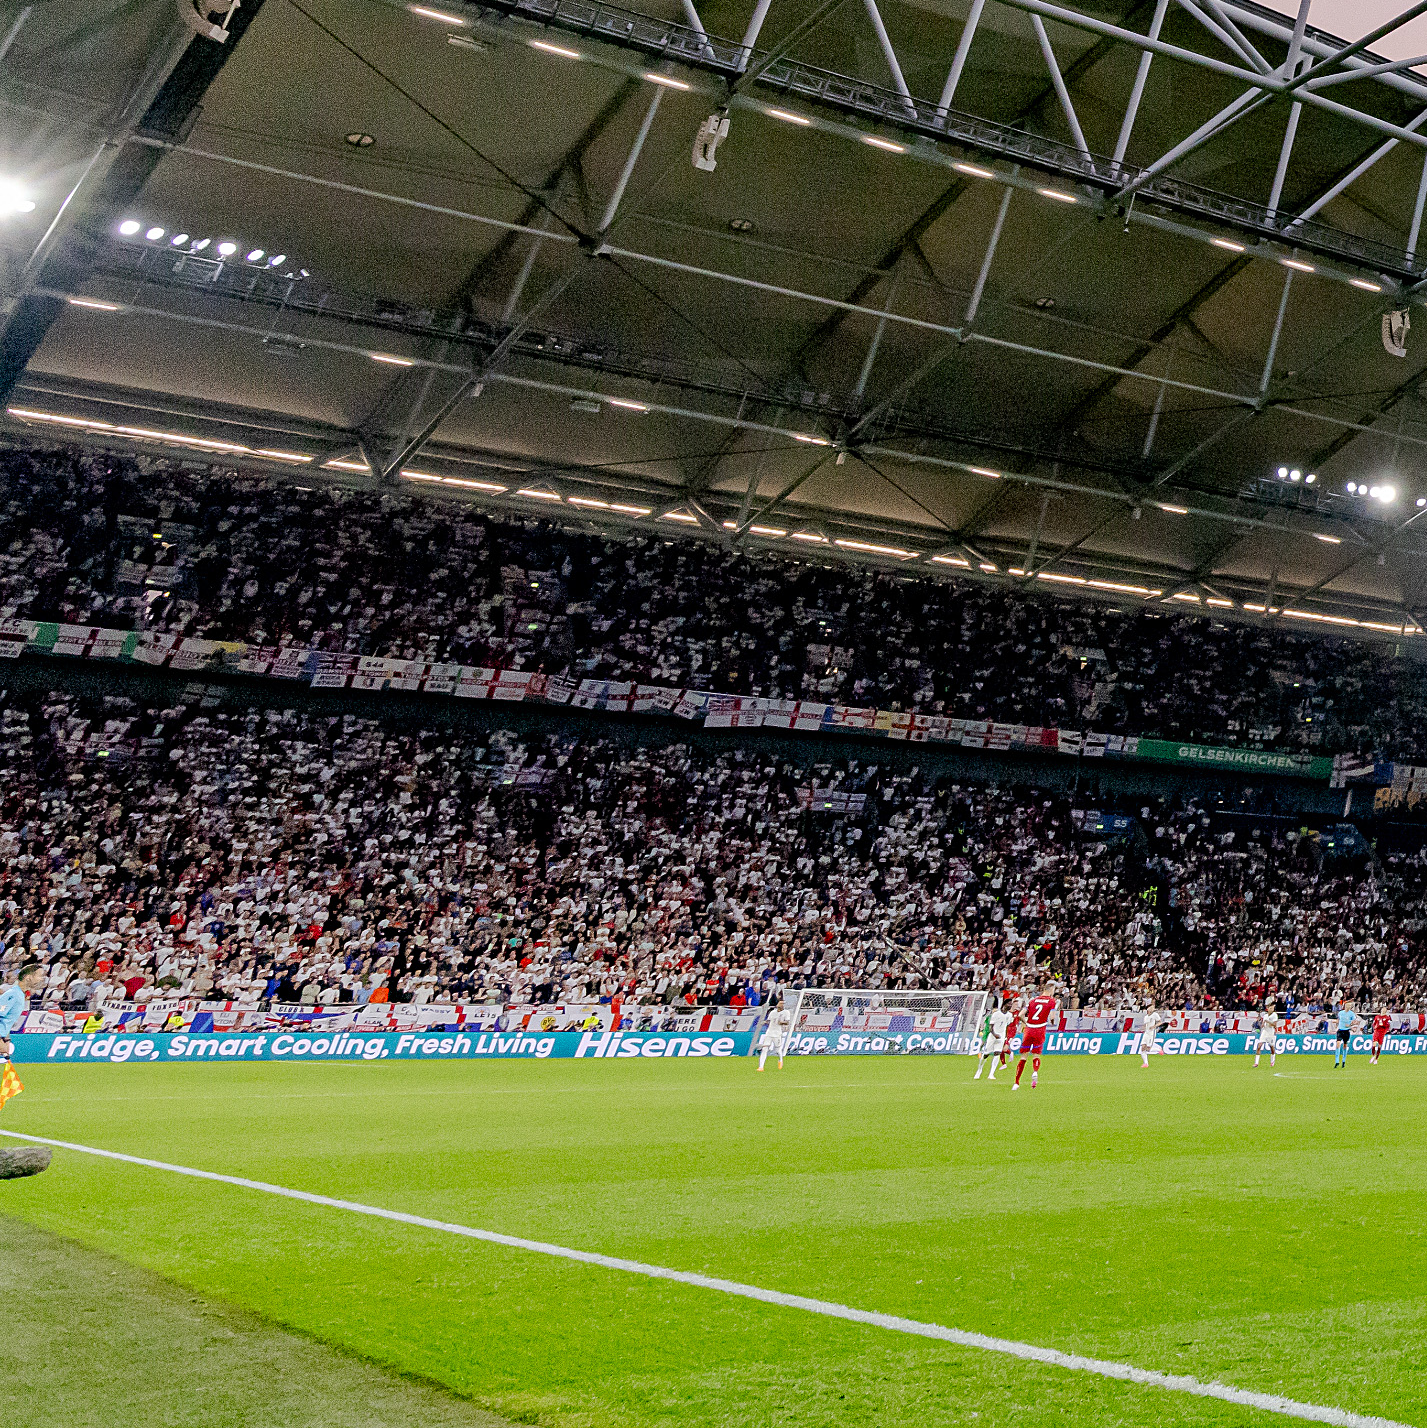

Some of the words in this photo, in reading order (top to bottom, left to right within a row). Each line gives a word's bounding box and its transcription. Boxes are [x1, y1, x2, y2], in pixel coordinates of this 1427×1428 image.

[1178, 746, 1296, 769] GELSENKIRCHEN
[101, 1000, 133, 1011] DYNAMO
[1031, 1004, 1043, 1020] 2
[48, 1034, 159, 1063] Fridge,
[168, 1035, 267, 1057] Smart
[271, 1033, 389, 1060] Cooling,
[395, 1032, 471, 1054] Fresh
[475, 1031, 556, 1058] Living
[574, 1032, 736, 1058] Hisense
[1046, 1032, 1102, 1054] Living
[1116, 1033, 1230, 1055] Hsense
